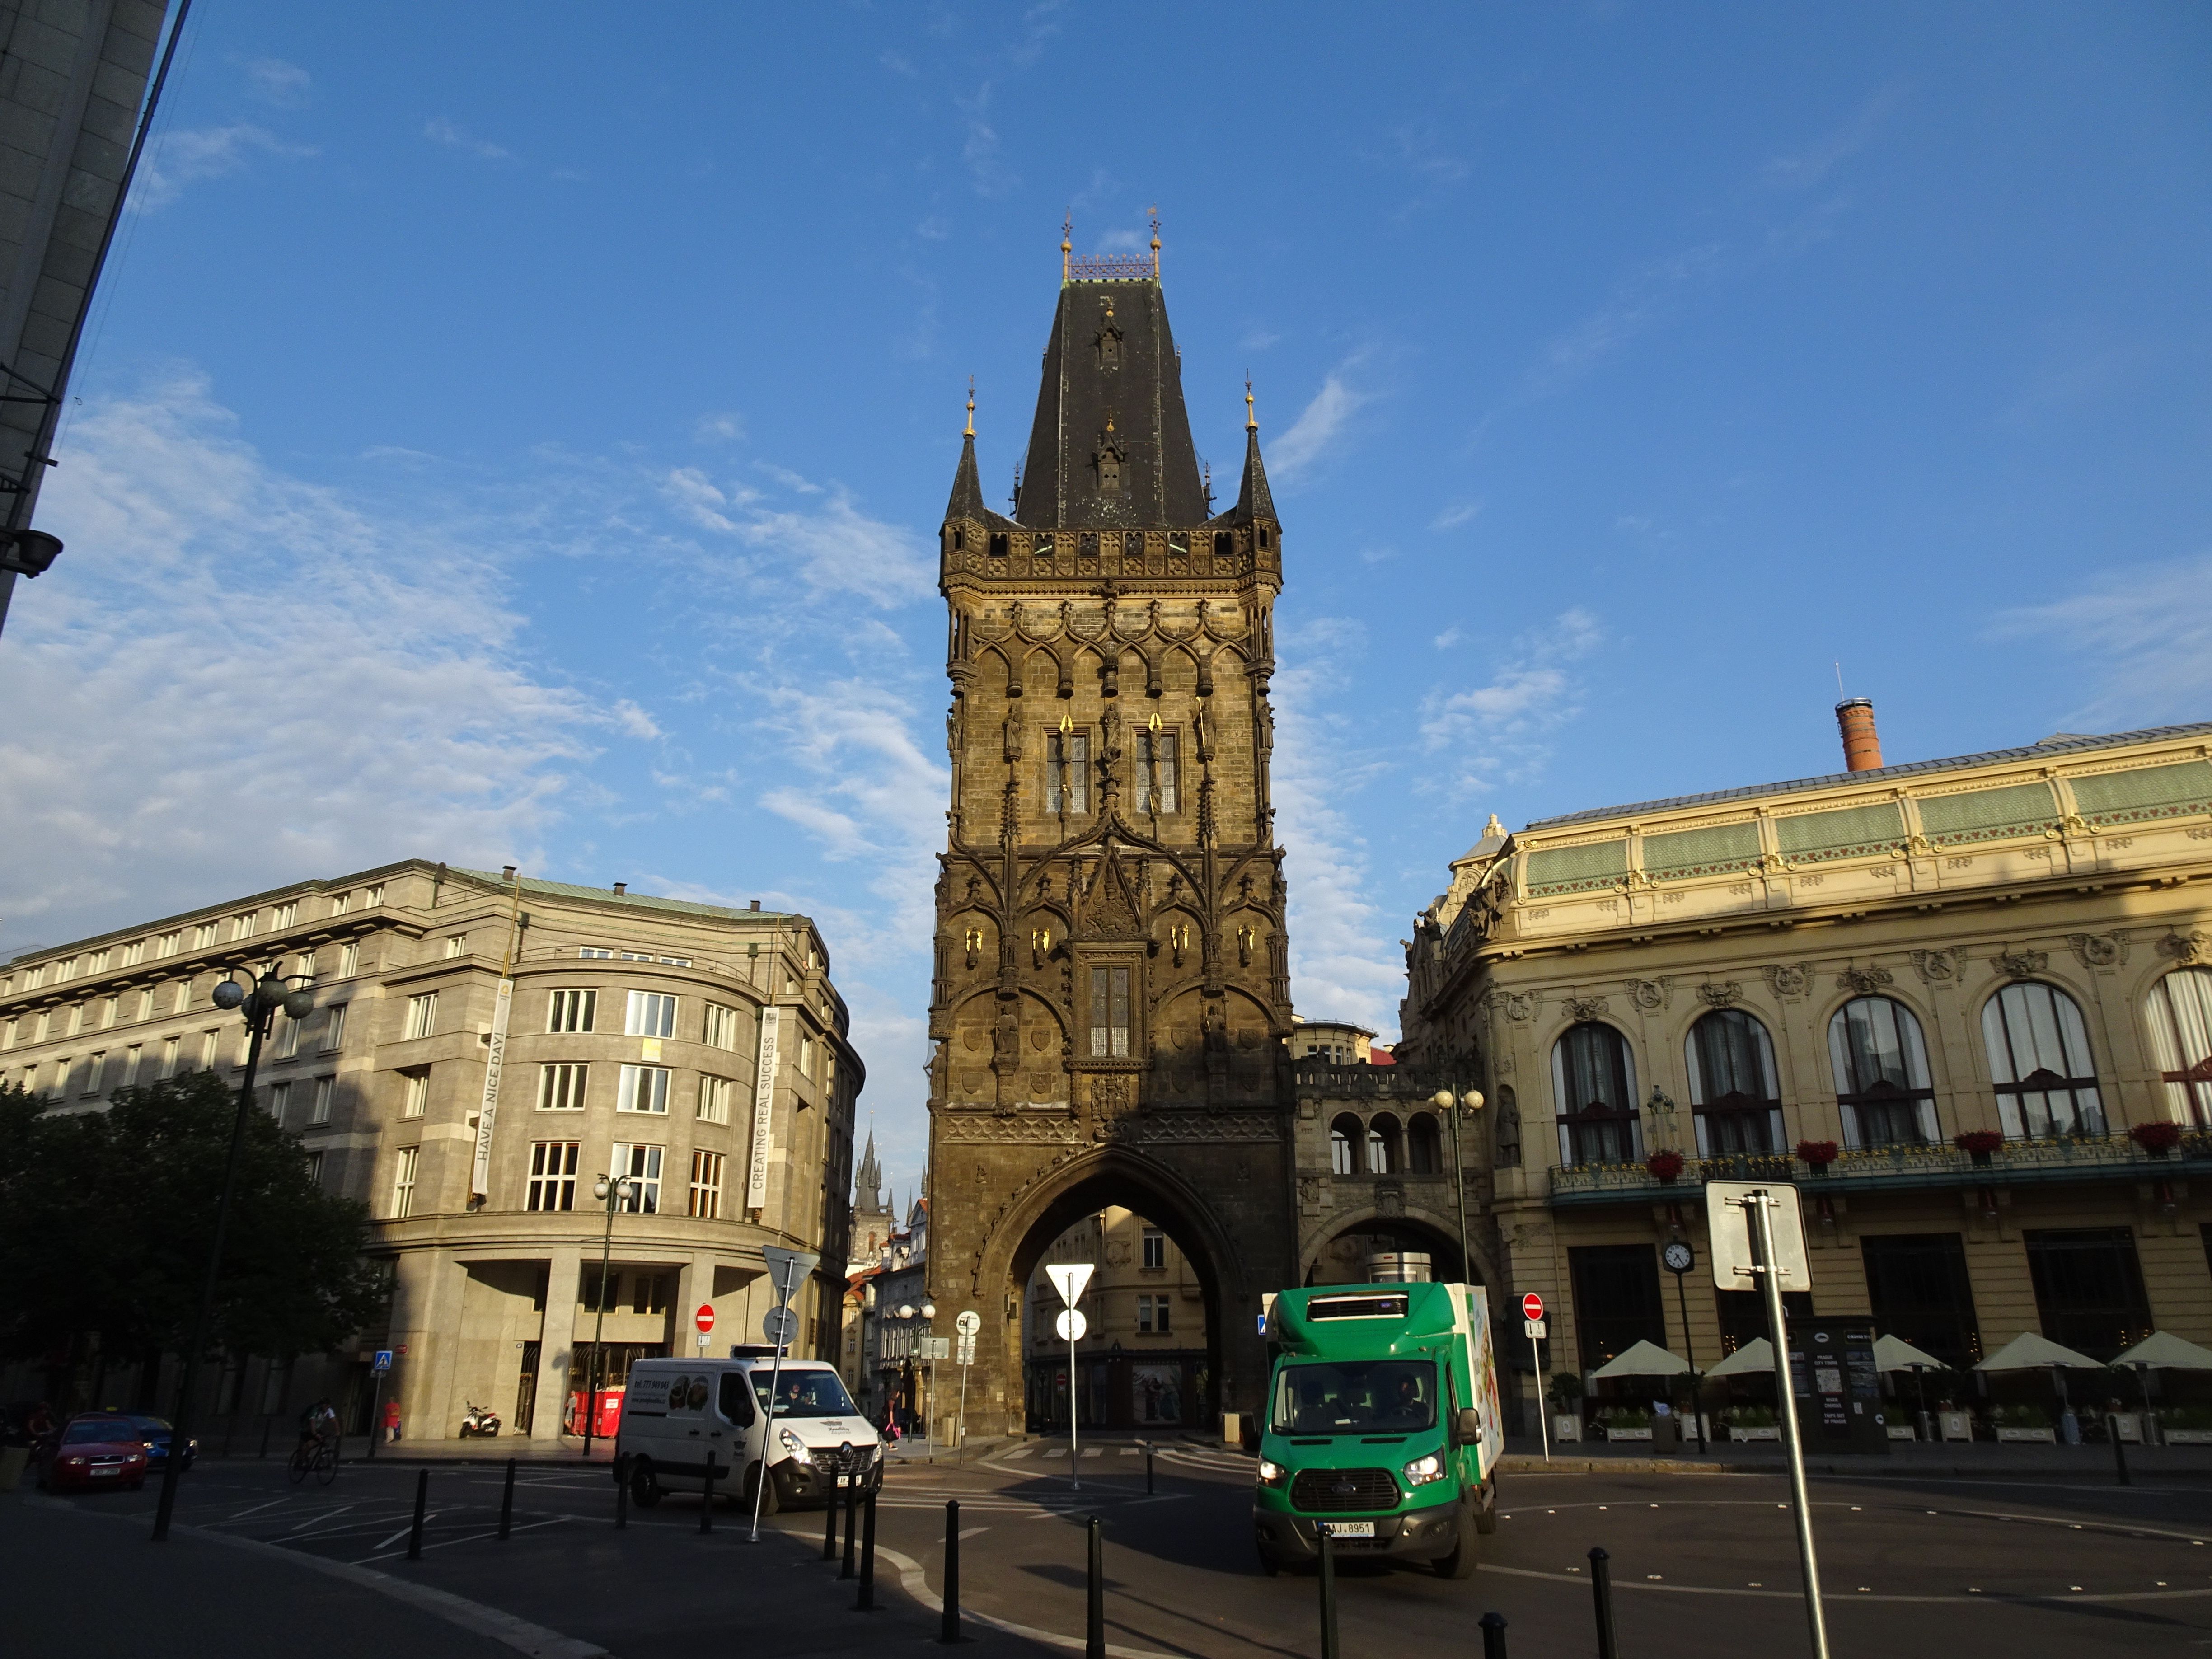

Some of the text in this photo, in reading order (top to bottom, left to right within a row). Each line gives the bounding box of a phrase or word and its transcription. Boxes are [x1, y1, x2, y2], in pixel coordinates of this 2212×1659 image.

[760, 1037, 774, 1089] SUCCESS
[478, 1032, 504, 1160] HAVE A NICE DAY!
[757, 1094, 769, 1124] REAL
[752, 1129, 766, 1189] CREATING
[643, 1380, 652, 1388] 777
